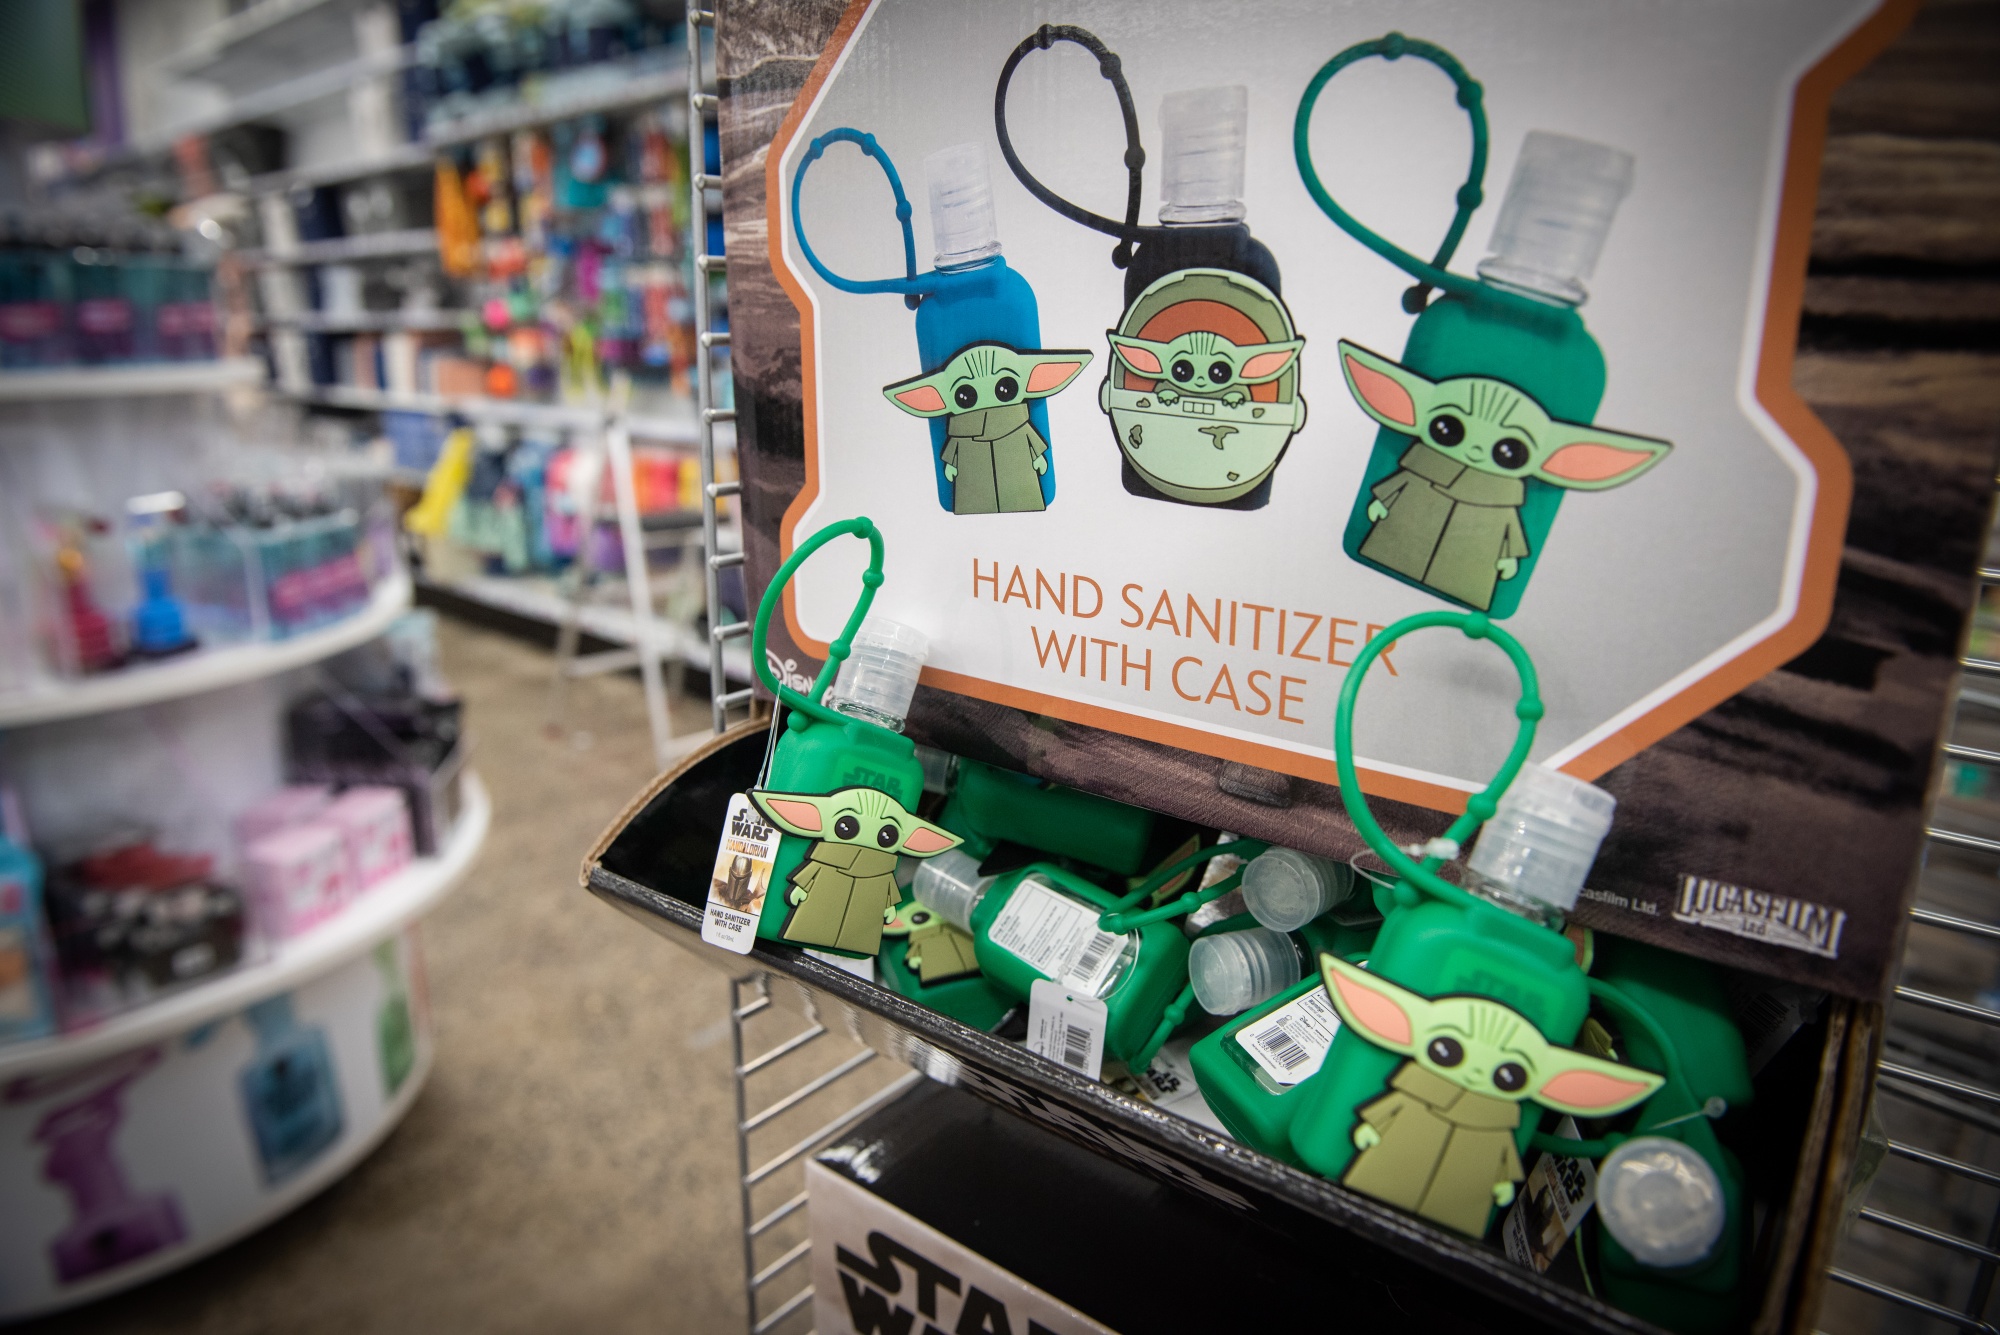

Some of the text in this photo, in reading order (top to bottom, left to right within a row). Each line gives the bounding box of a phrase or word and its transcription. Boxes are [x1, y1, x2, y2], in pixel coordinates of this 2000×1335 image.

[973, 558, 1399, 677] HAND SANITIZER
[1031, 625, 1308, 725] WITH CASE
[732, 820, 773, 842] WARS
[709, 908, 751, 926] HAND SANITIZER
[714, 917, 742, 932] WITH CASE
[836, 1230, 1060, 1335] STA
